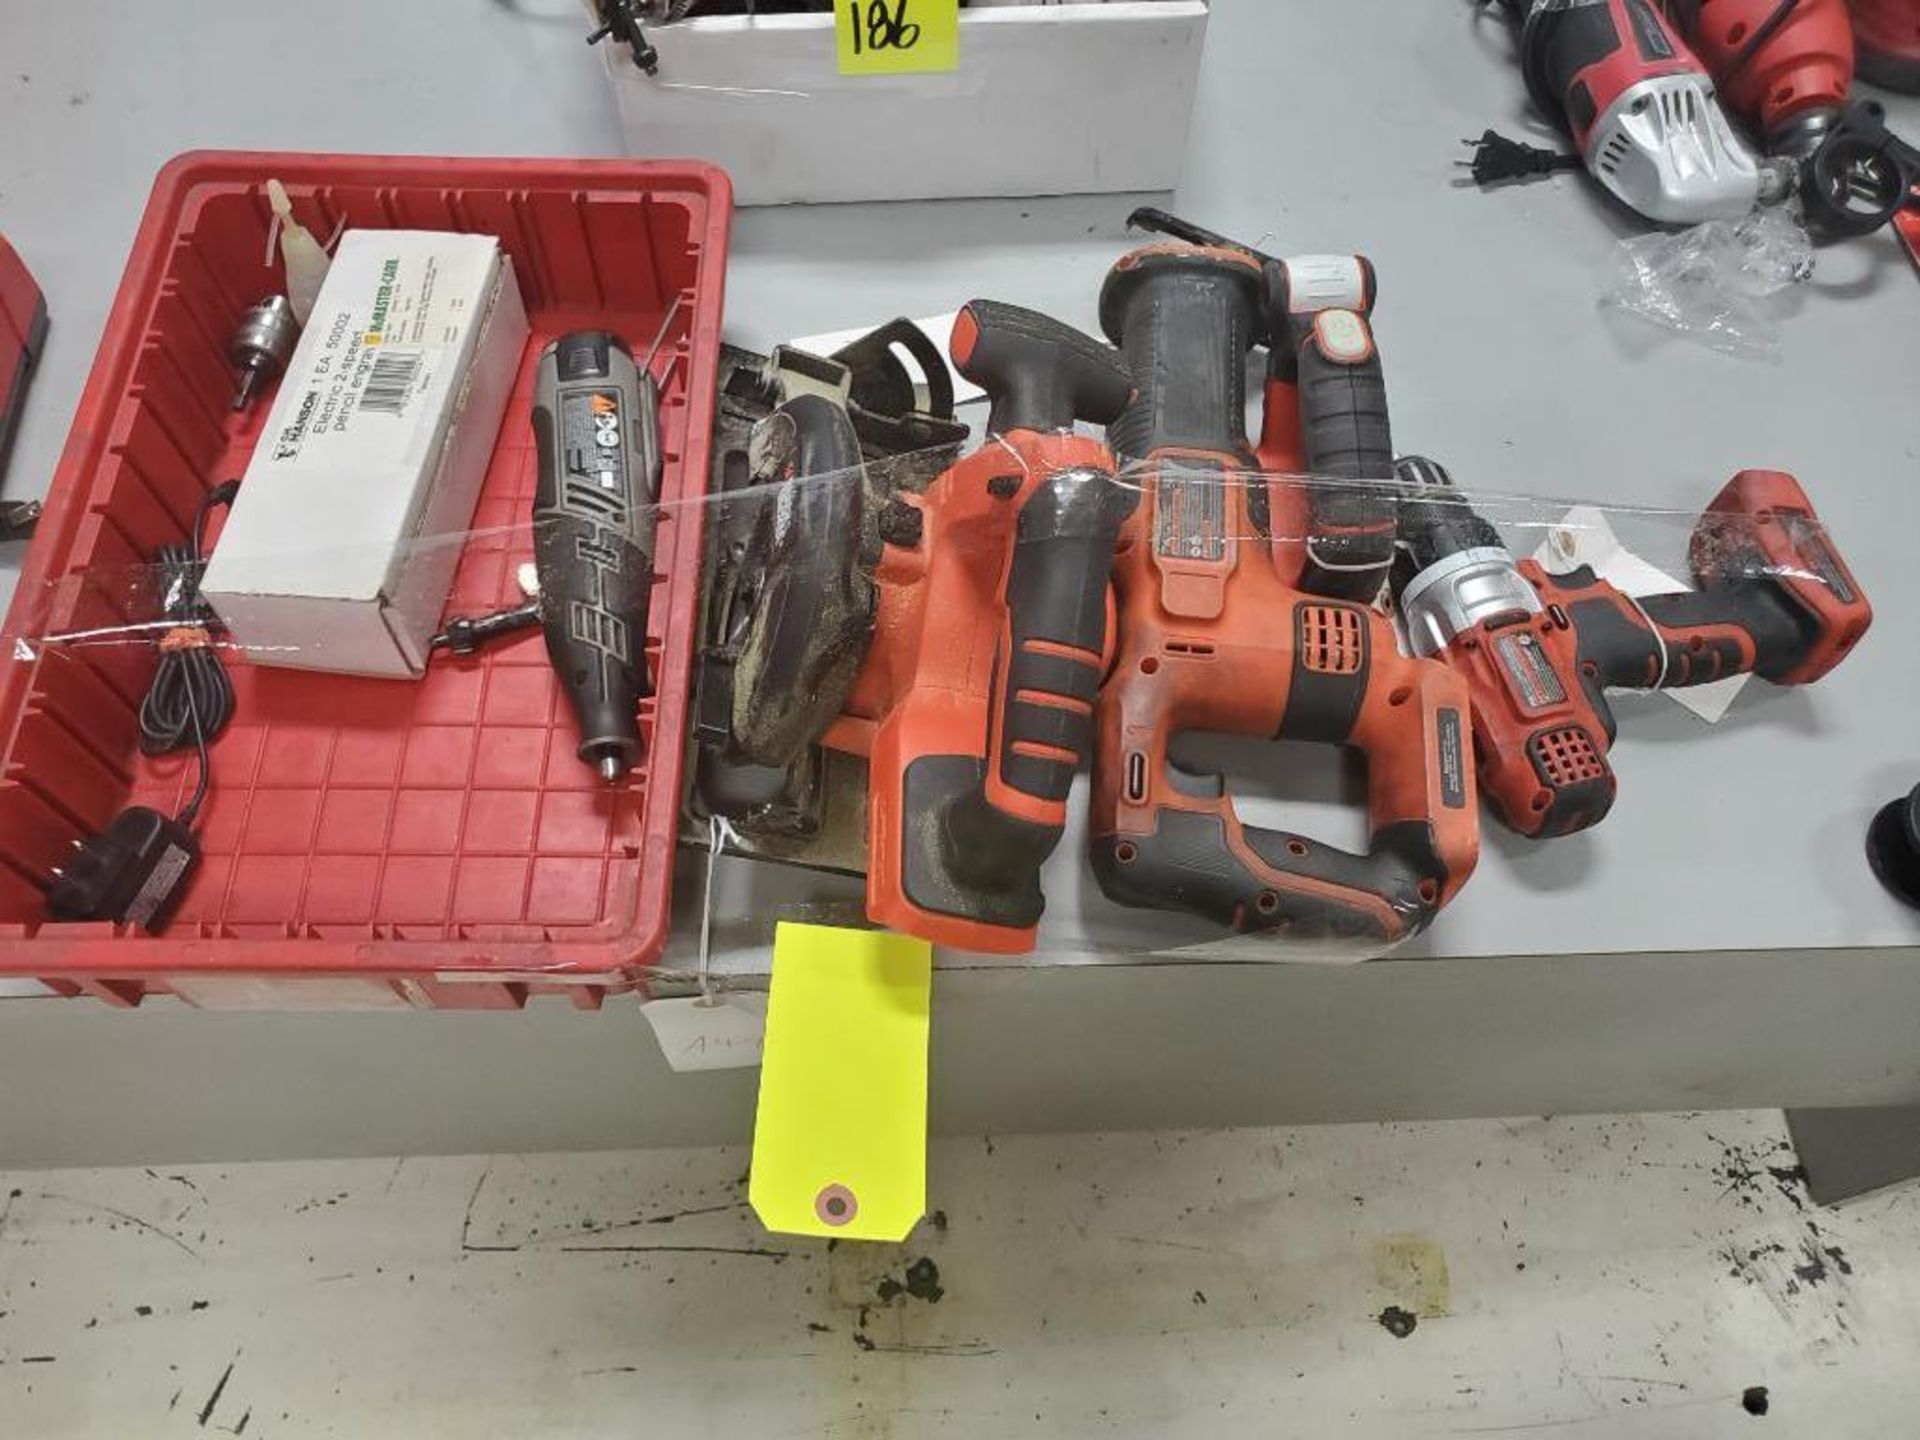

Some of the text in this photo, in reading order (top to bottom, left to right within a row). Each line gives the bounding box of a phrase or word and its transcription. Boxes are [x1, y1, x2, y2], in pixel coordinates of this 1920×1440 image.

[850, 0, 921, 55] 186
[314, 354, 332, 373] EA
[326, 312, 351, 350] 50002
[288, 391, 317, 441] HANSON
[312, 385, 343, 434] Electric
